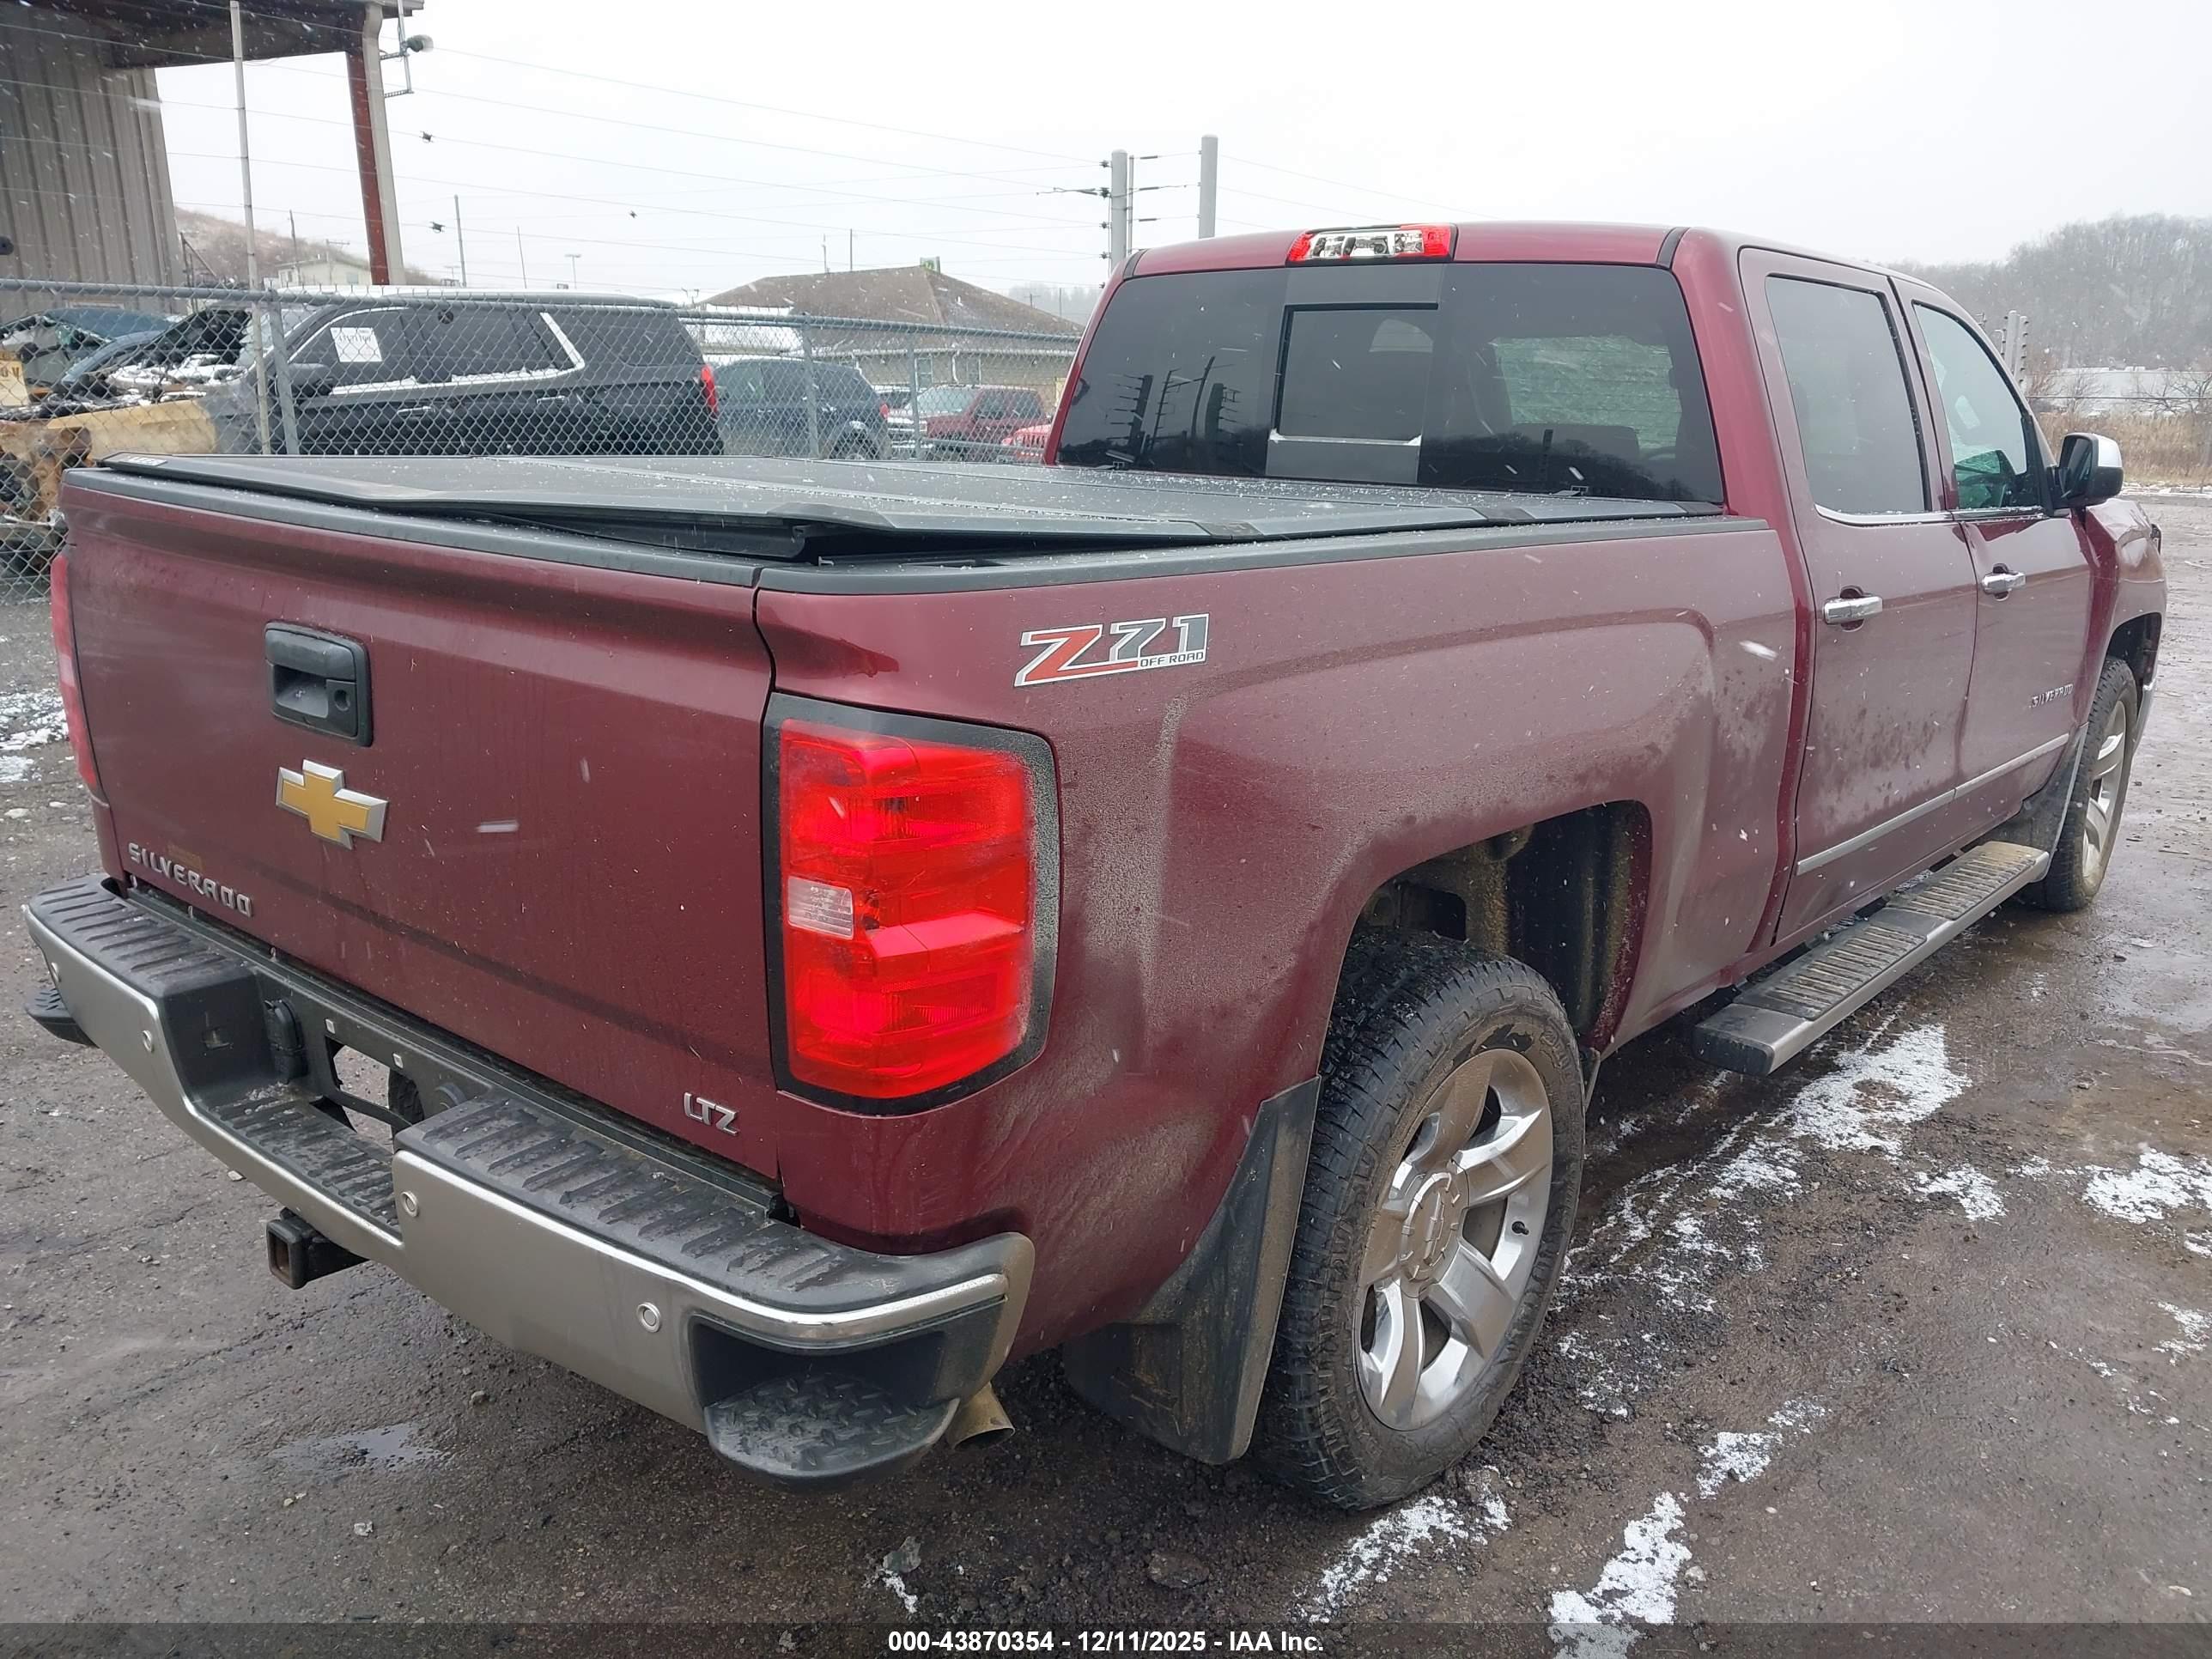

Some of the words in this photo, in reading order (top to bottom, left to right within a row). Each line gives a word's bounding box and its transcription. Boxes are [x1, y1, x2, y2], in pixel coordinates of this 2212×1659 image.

[1014, 613, 1209, 686] Z71
[1140, 657, 1165, 667] OFF
[1169, 653, 1203, 665] ROAD
[128, 842, 252, 918] SILVERADO
[684, 1092, 738, 1134] LTZ
